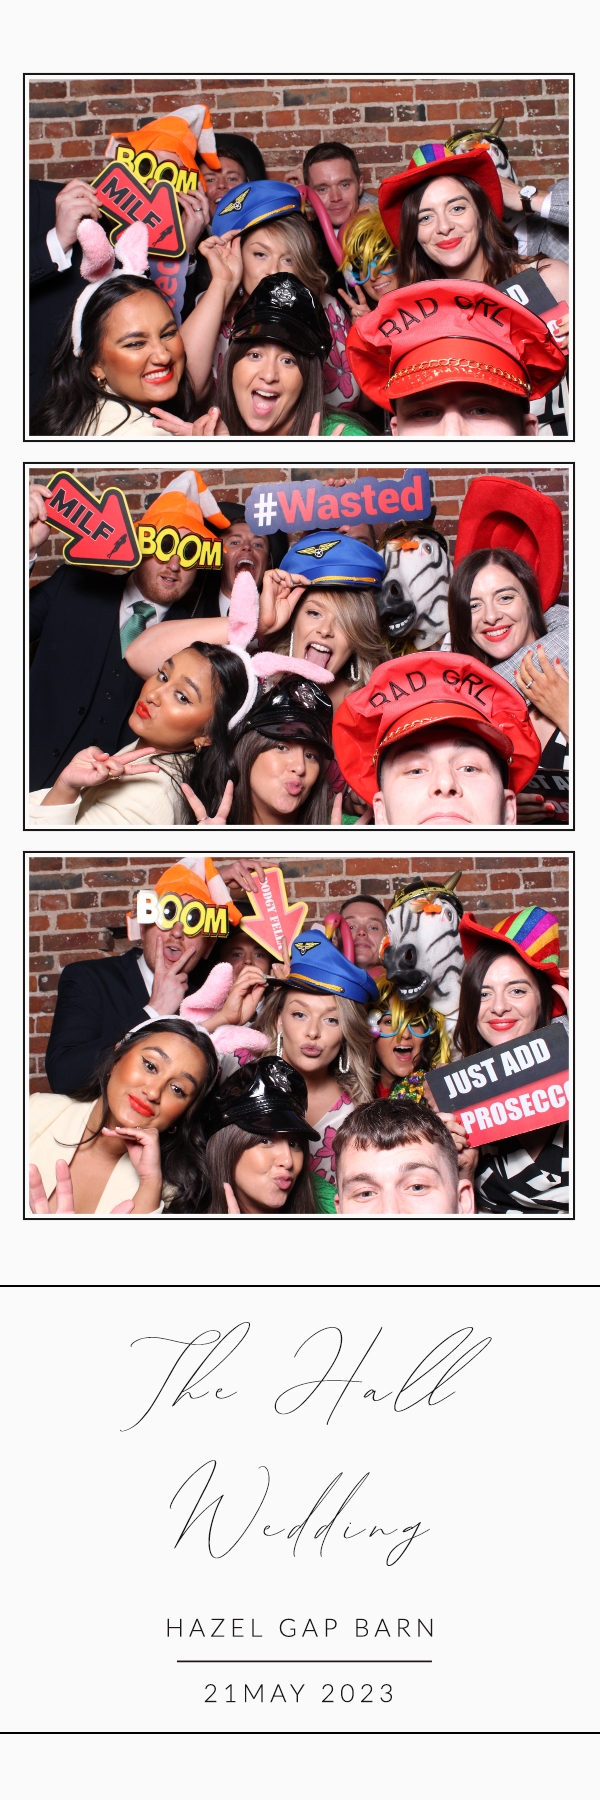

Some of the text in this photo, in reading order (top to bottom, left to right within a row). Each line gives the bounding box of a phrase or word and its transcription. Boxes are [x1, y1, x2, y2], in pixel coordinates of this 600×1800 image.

[116, 145, 198, 194] BOOM
[101, 175, 163, 229] MILF
[378, 297, 439, 338] BAD
[48, 487, 115, 542] MILF
[253, 475, 424, 527] #Wasted
[137, 524, 223, 571] BOOM
[137, 889, 230, 938] BOOM
[443, 1038, 551, 1099] JUST ADD
